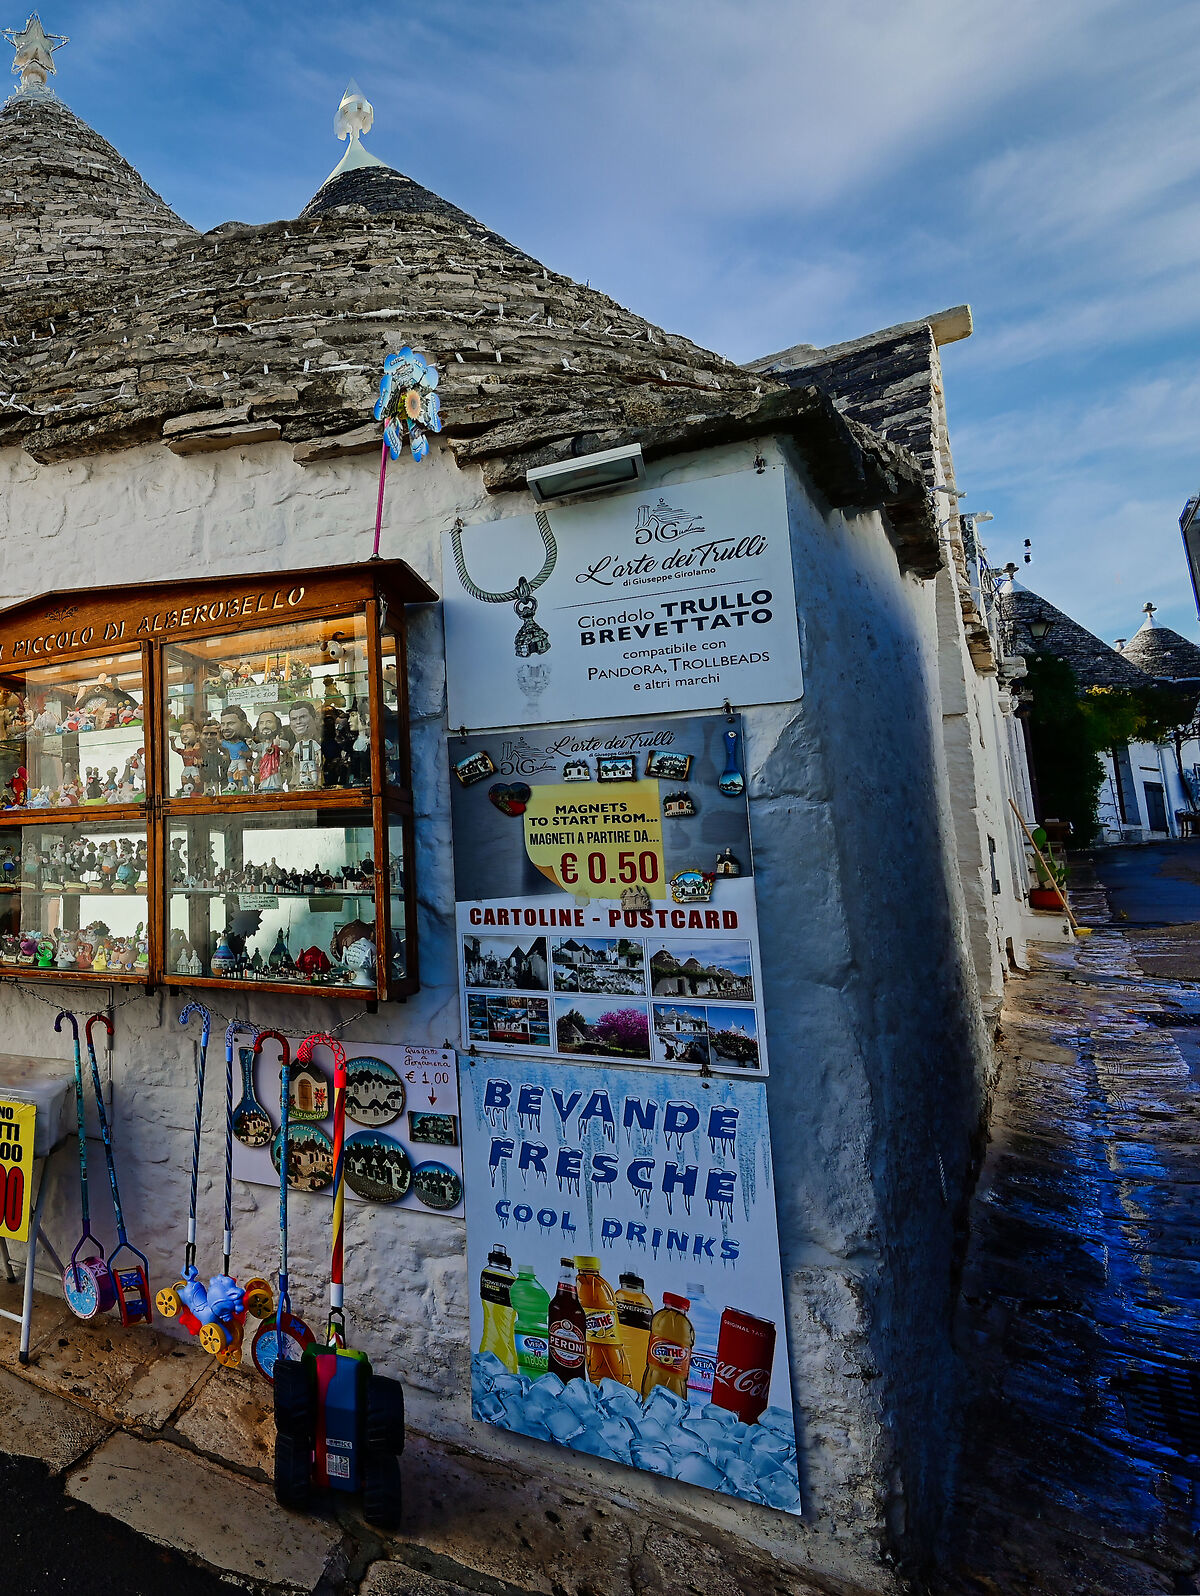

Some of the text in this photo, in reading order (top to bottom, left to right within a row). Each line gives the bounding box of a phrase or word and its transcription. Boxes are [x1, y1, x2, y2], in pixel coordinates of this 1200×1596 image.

[575, 534, 768, 587] L'arte dei Trulli
[623, 567, 716, 587] di Giuseppe Girolamo
[12, 626, 94, 657] PICCOLO
[103, 620, 126, 641] DI
[138, 586, 306, 633] ALBEROBELLO
[577, 589, 774, 629] Ciondolo TRULLO
[580, 608, 774, 647] BREVETTATO
[622, 639, 727, 661] compatibile con
[587, 651, 770, 682] PANDORA, TROLLBEADS
[633, 673, 720, 692] e altri marchi
[546, 730, 676, 757] L'arte dei Trulli
[529, 817, 549, 827] TO
[552, 815, 600, 826] START
[603, 813, 659, 825] FROM...
[555, 803, 628, 815] MAGNETS
[529, 830, 660, 846] MAGNETI A PARTIRE DA...
[560, 851, 659, 884] € 0.50
[469, 907, 585, 928] CARTOLINE
[609, 909, 739, 930] POSTCARD
[405, 1070, 417, 1084] €
[484, 1078, 739, 1155] BEVANDE
[488, 1137, 737, 1218] FRESCHE
[495, 1200, 576, 1239] COOL
[601, 1217, 740, 1266] DRINKS
[550, 1335, 584, 1353] PERONI
[693, 1358, 714, 1370] VERA
